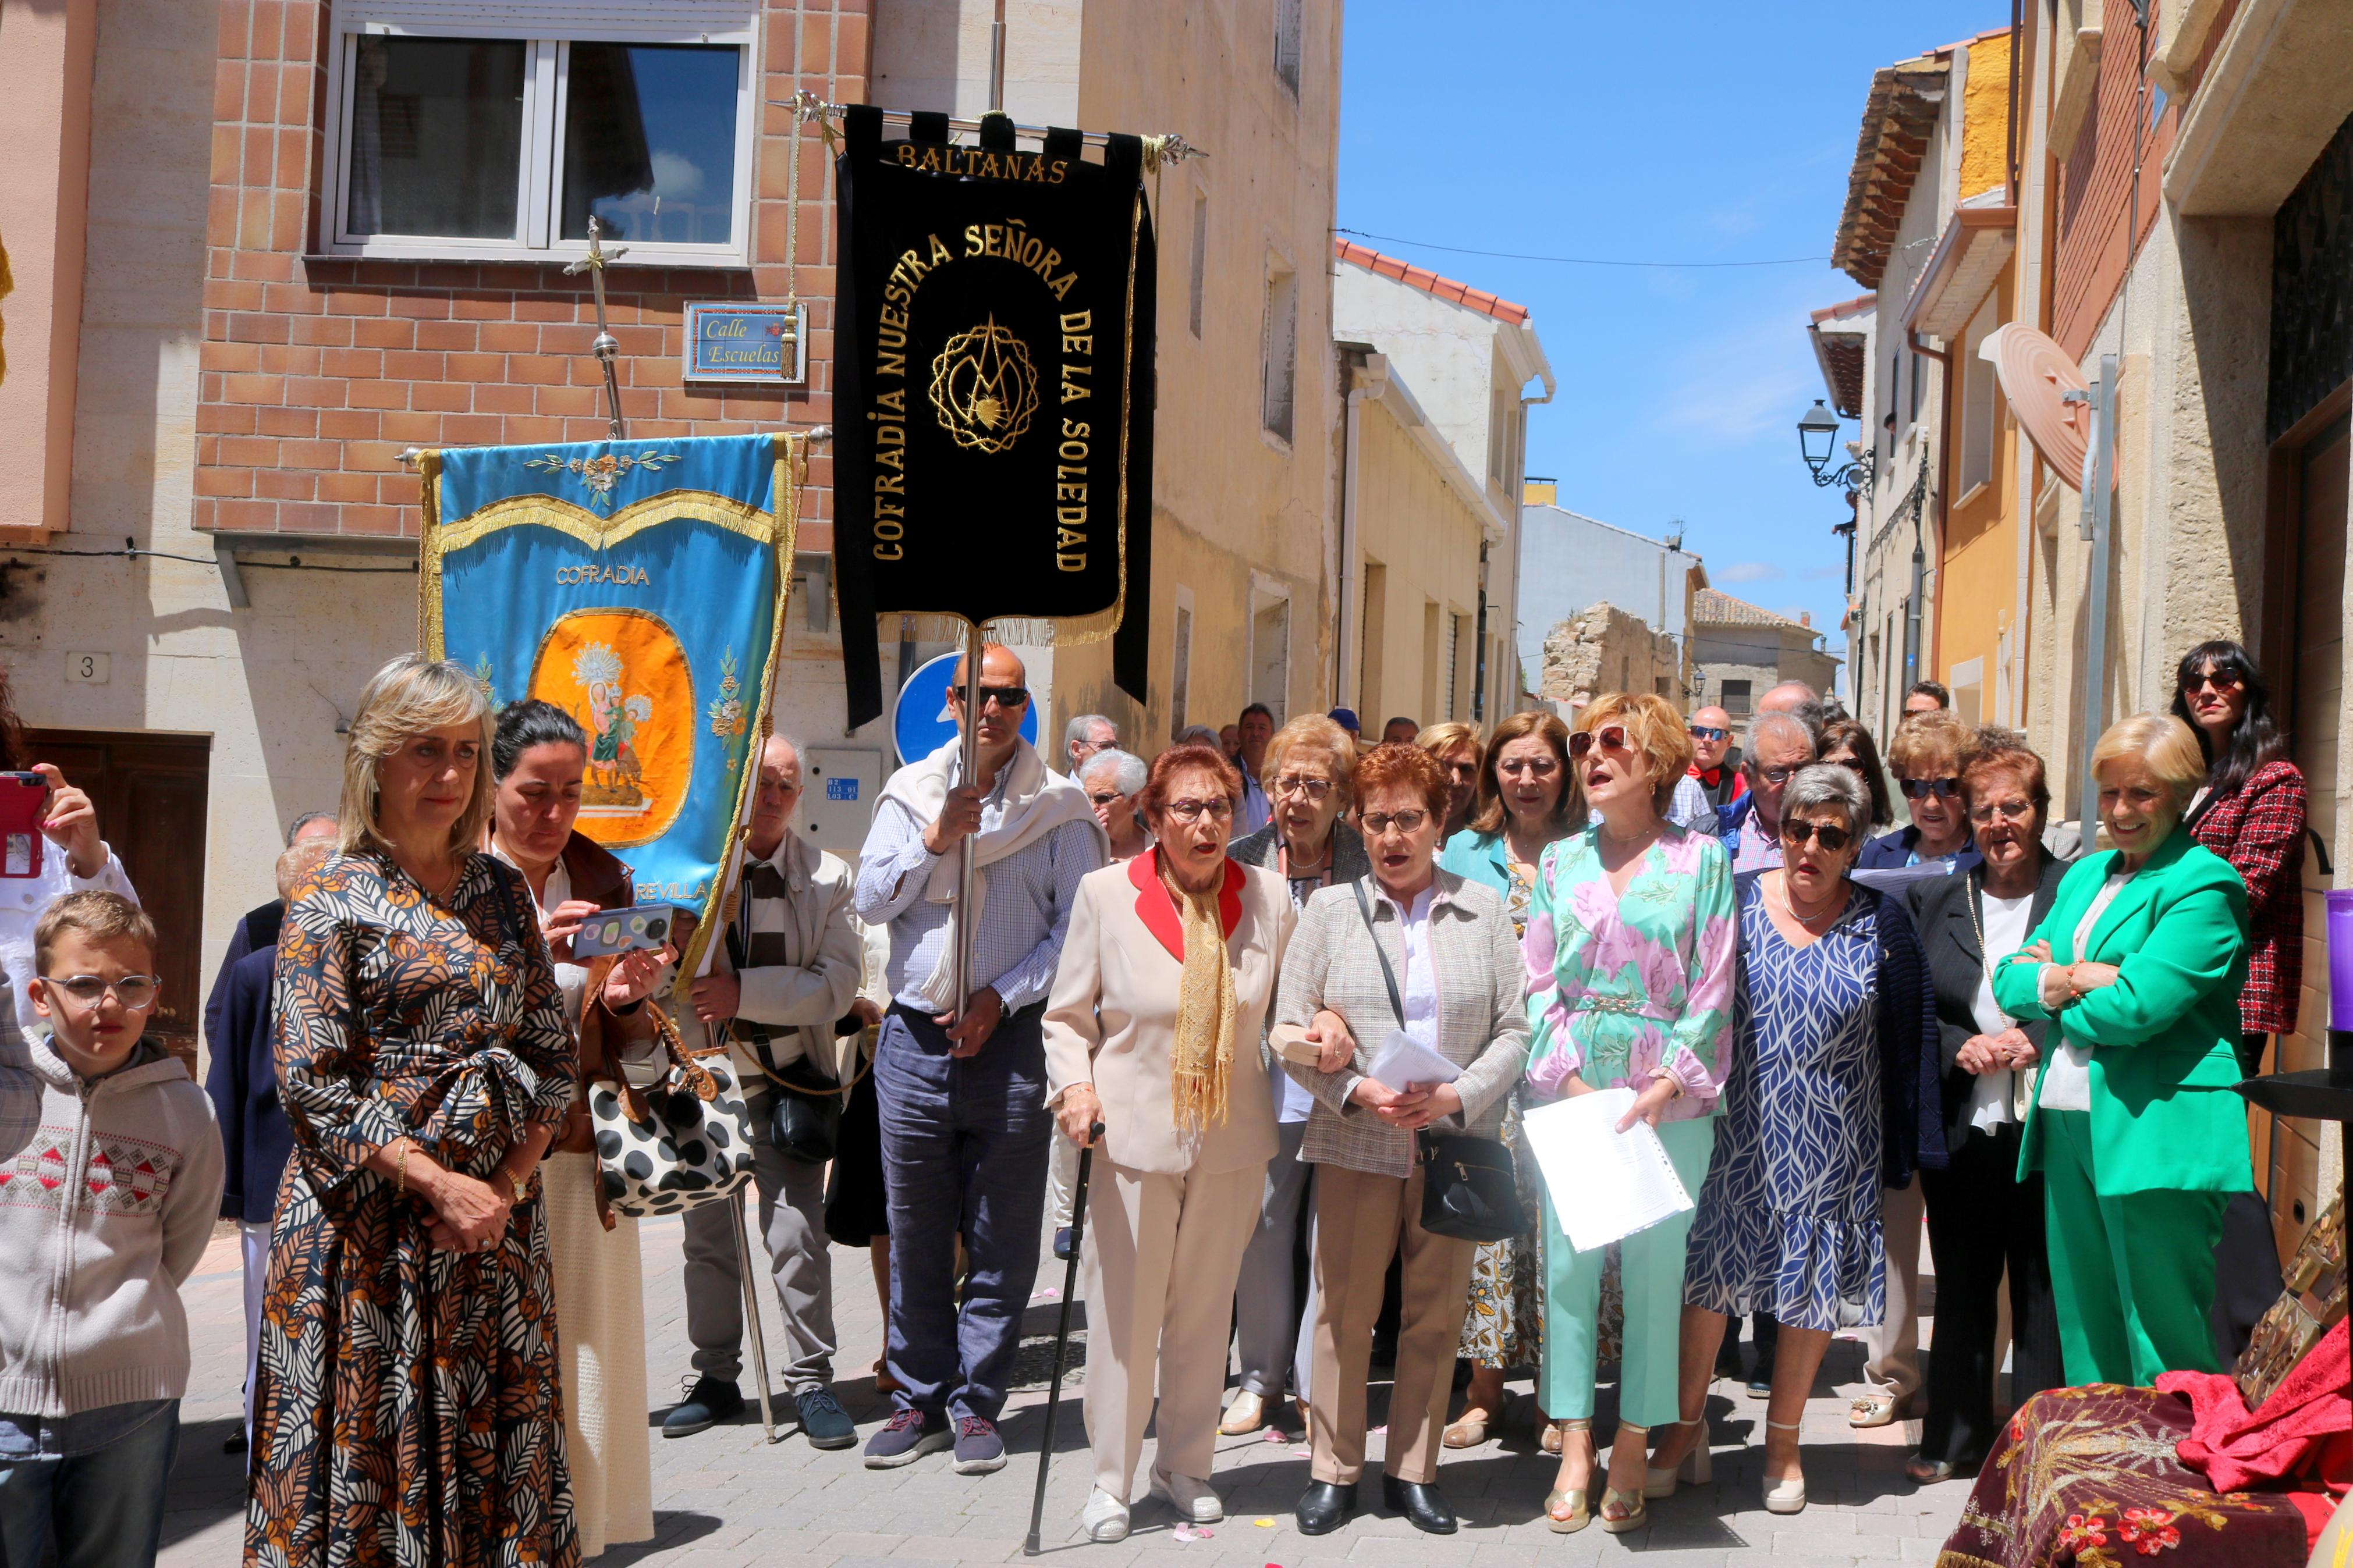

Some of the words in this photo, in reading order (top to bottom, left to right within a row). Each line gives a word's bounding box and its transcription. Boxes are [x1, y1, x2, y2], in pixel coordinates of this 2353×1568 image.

[964, 217, 1078, 302] SEÑORA
[876, 233, 954, 377] NUESTRA
[706, 319, 747, 339] Calle
[1059, 308, 1093, 356] DE
[708, 344, 780, 363] Escuelas
[1060, 363, 1092, 405] LA
[1056, 418, 1091, 573] SOLEDAD
[556, 564, 651, 587] COFRADIA
[81, 656, 93, 678] 3
[635, 881, 708, 901] REVILLA
